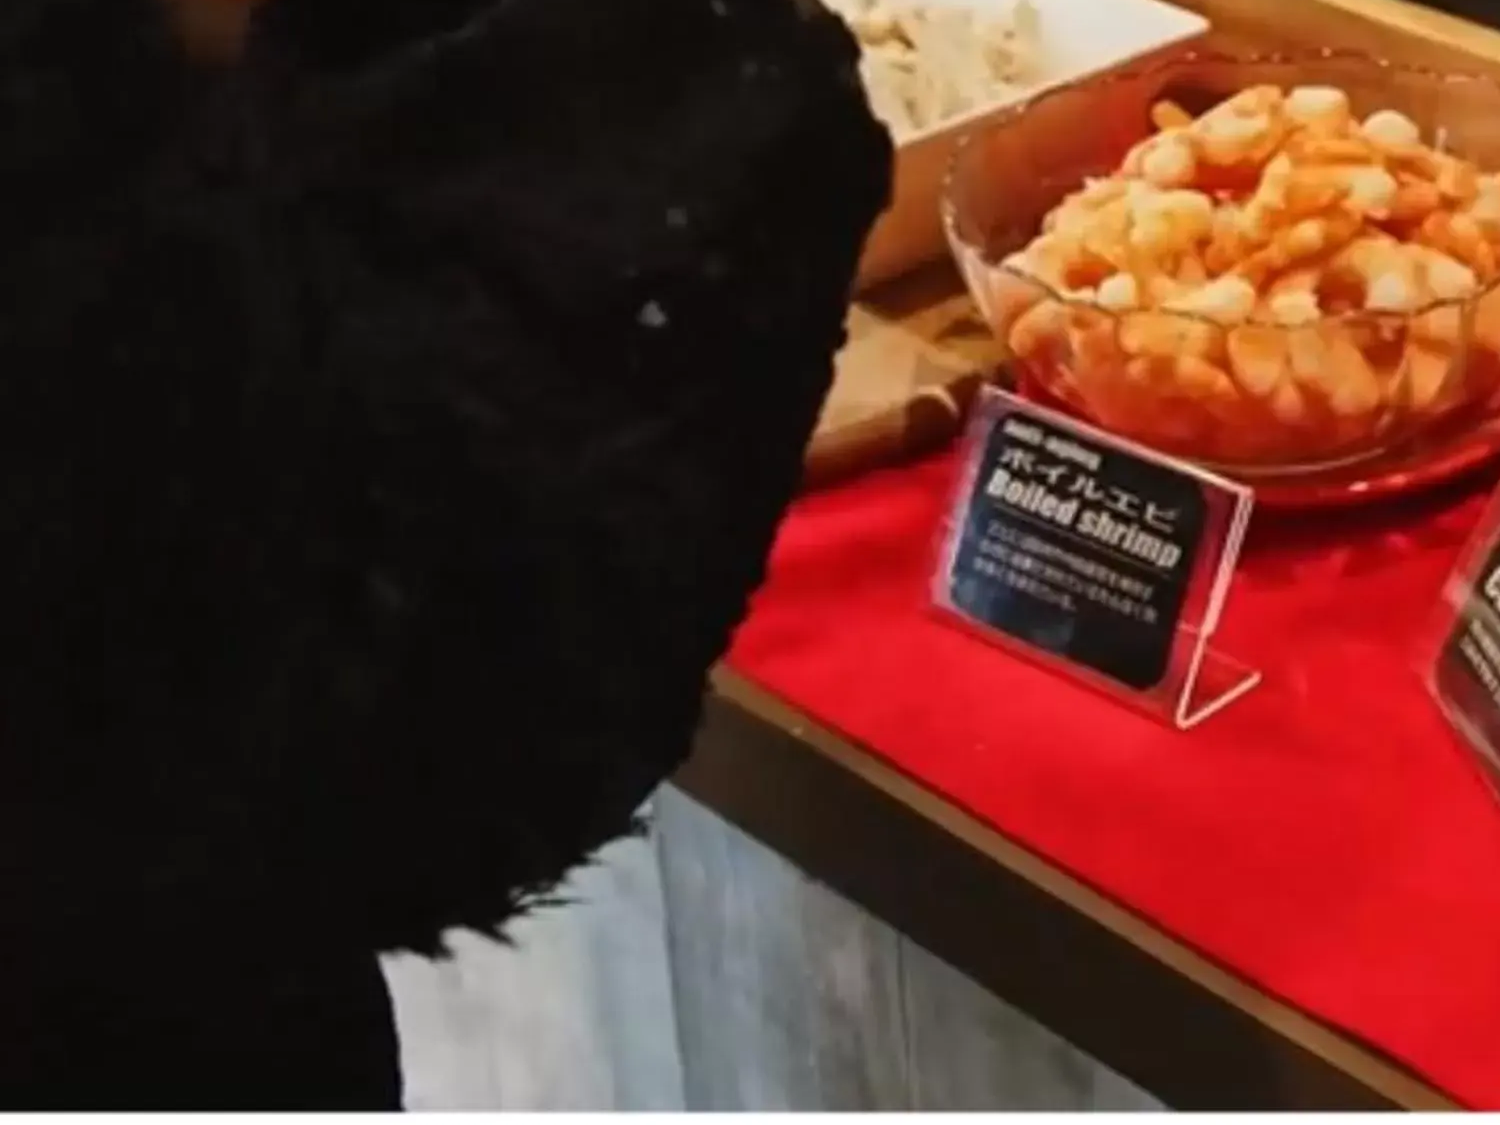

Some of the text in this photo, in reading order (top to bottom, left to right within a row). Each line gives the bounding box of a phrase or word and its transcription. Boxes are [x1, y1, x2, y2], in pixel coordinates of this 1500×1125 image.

[986, 468, 1182, 569] Boiled shrimp
[998, 448, 1180, 534] ボイルエビ
